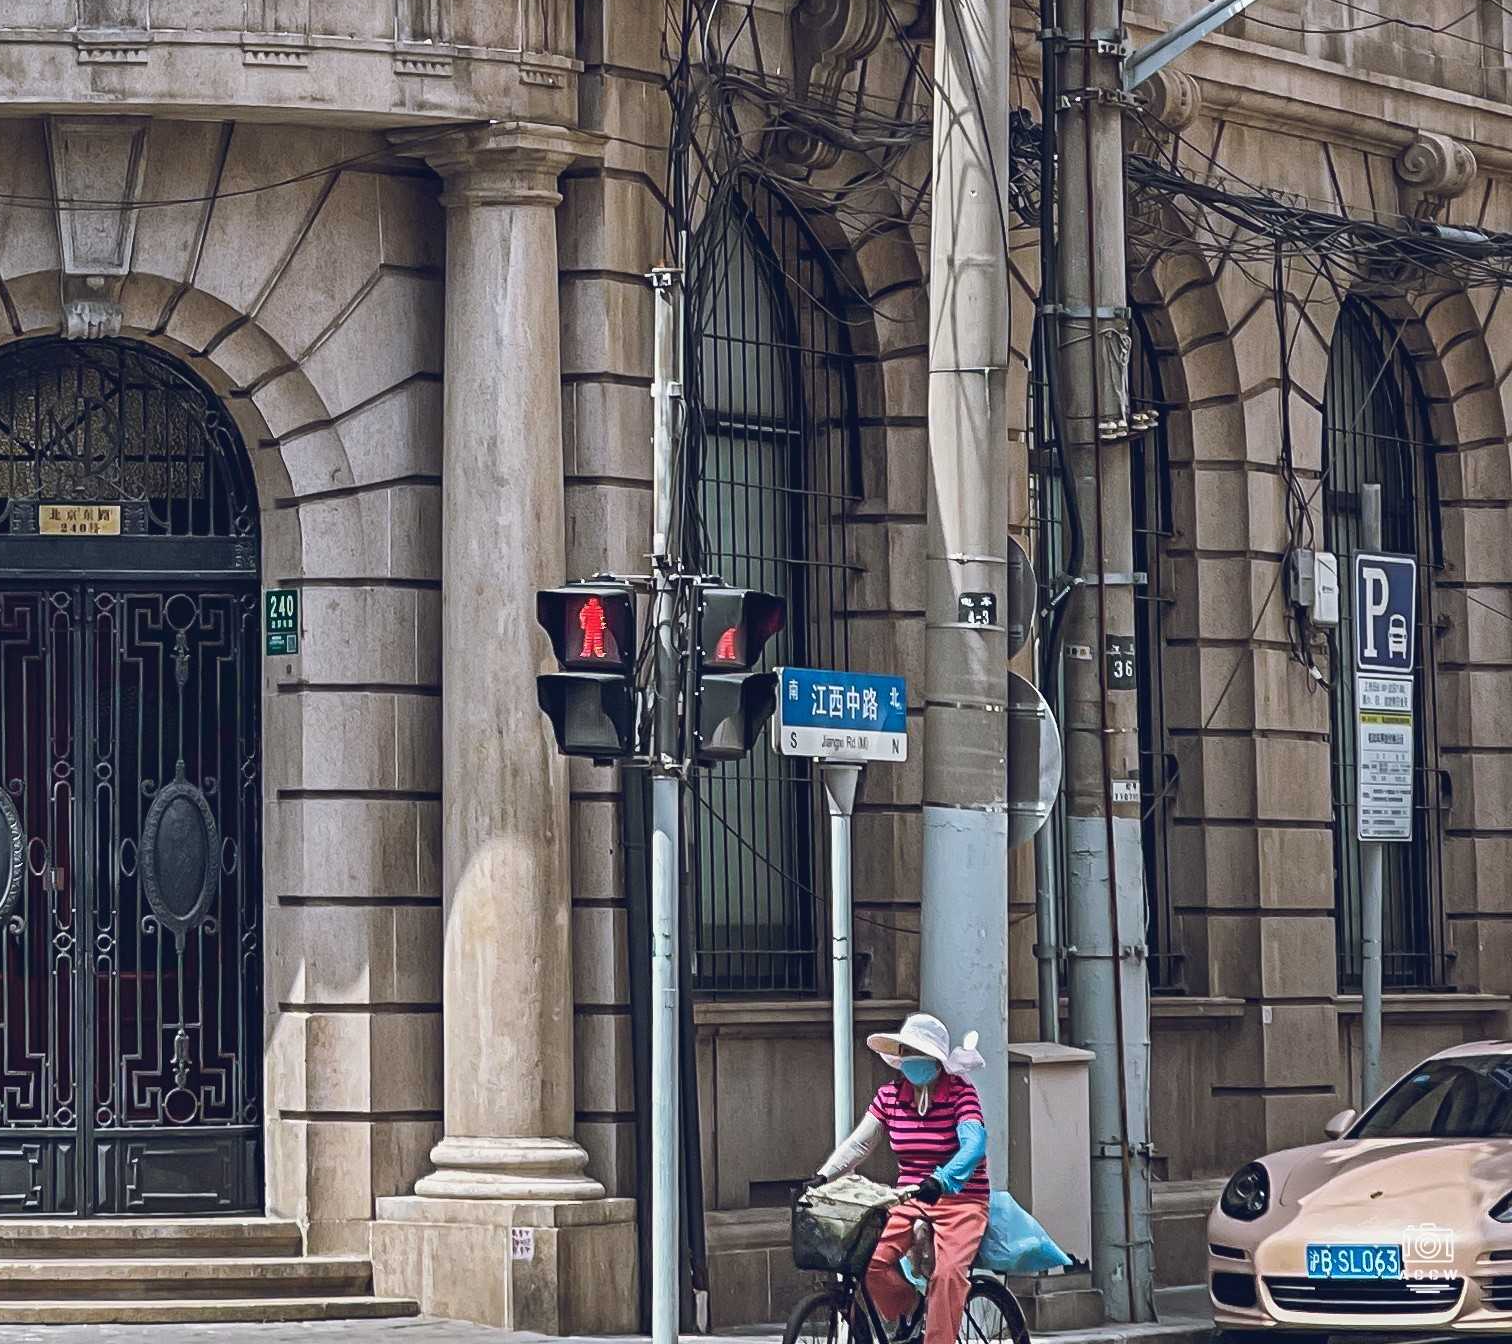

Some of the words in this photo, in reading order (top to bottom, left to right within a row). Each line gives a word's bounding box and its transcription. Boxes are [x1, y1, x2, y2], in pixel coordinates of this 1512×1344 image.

[270, 595, 294, 618] 240
[1362, 567, 1389, 658] P
[1113, 660, 1133, 678] 36
[788, 679, 799, 701] 南
[889, 687, 901, 708] 北
[811, 683, 878, 721] 江西中路
[790, 732, 798, 749] S
[892, 739, 900, 754] N
